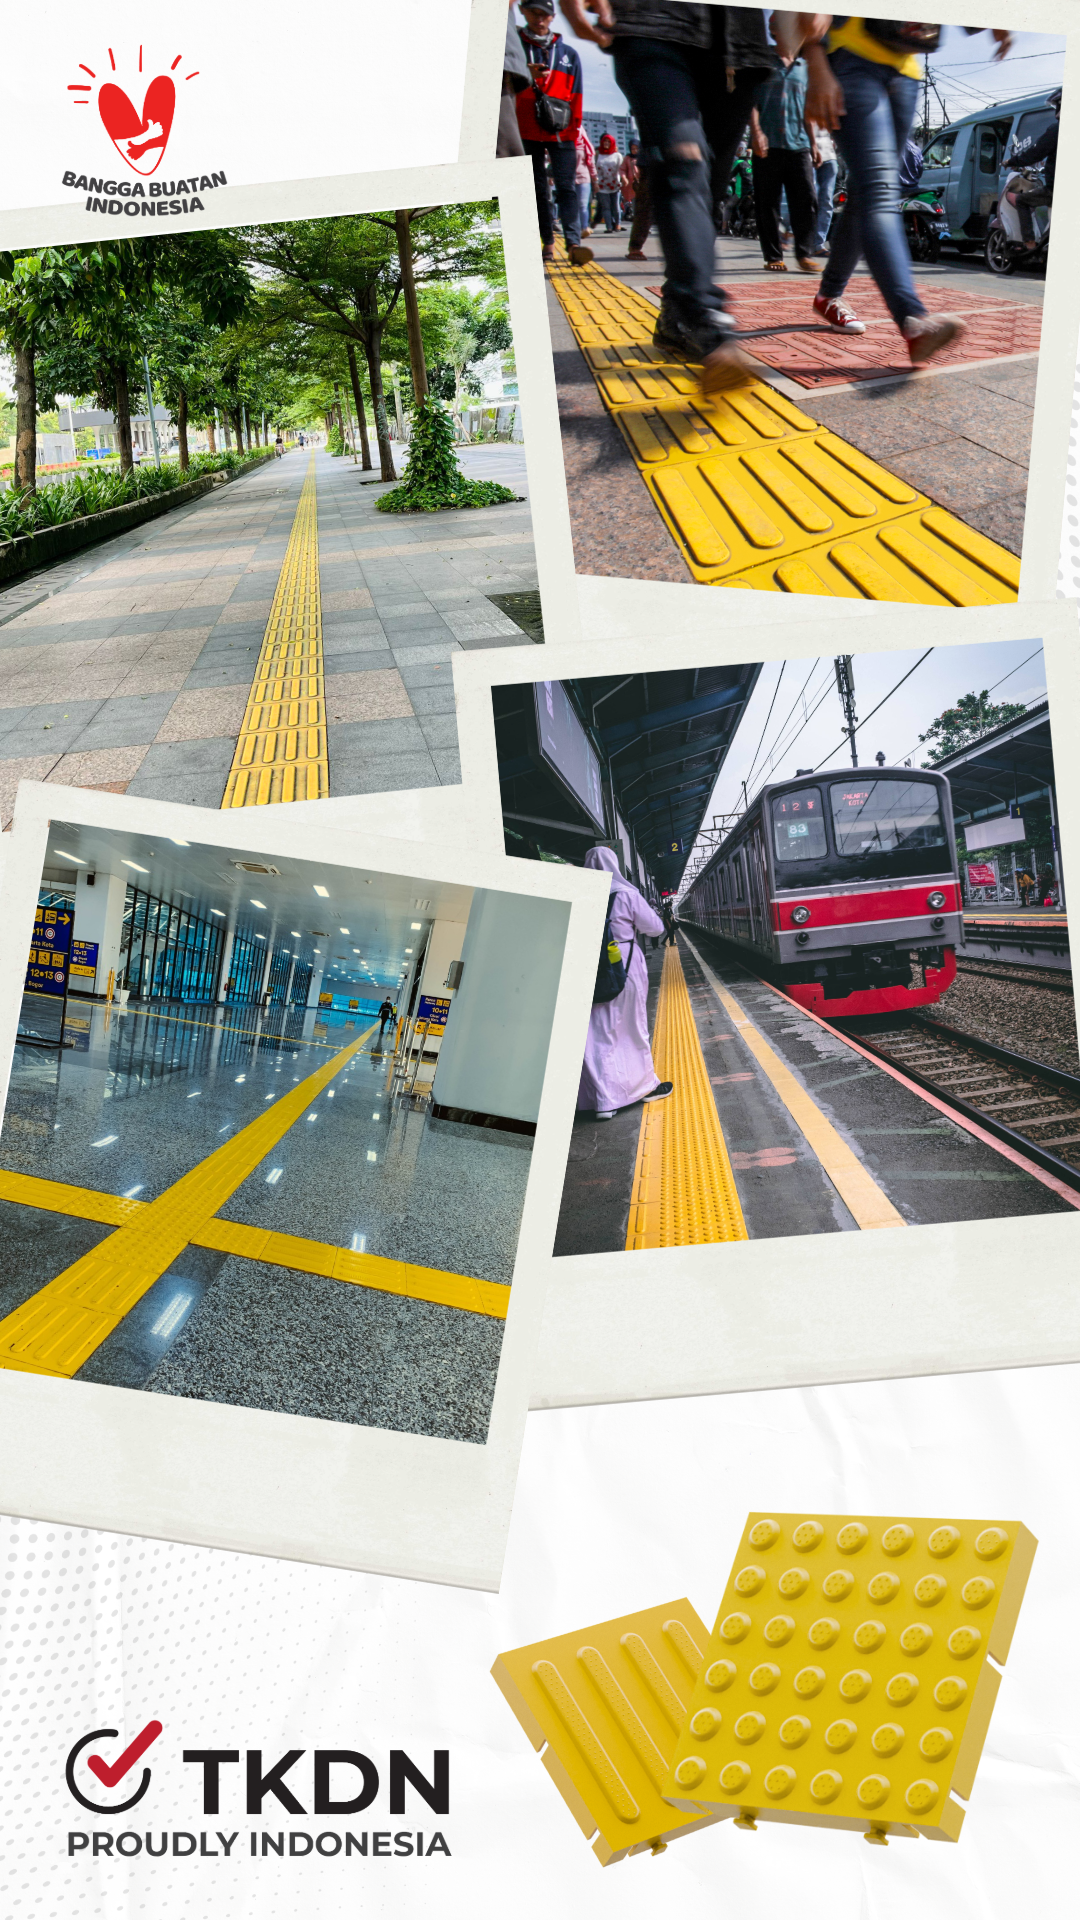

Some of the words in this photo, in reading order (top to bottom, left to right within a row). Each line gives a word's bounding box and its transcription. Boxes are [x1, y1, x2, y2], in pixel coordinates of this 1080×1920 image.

[1016, 807, 1021, 815] 1
[789, 823, 806, 834] 83
[671, 842, 679, 852] 2
